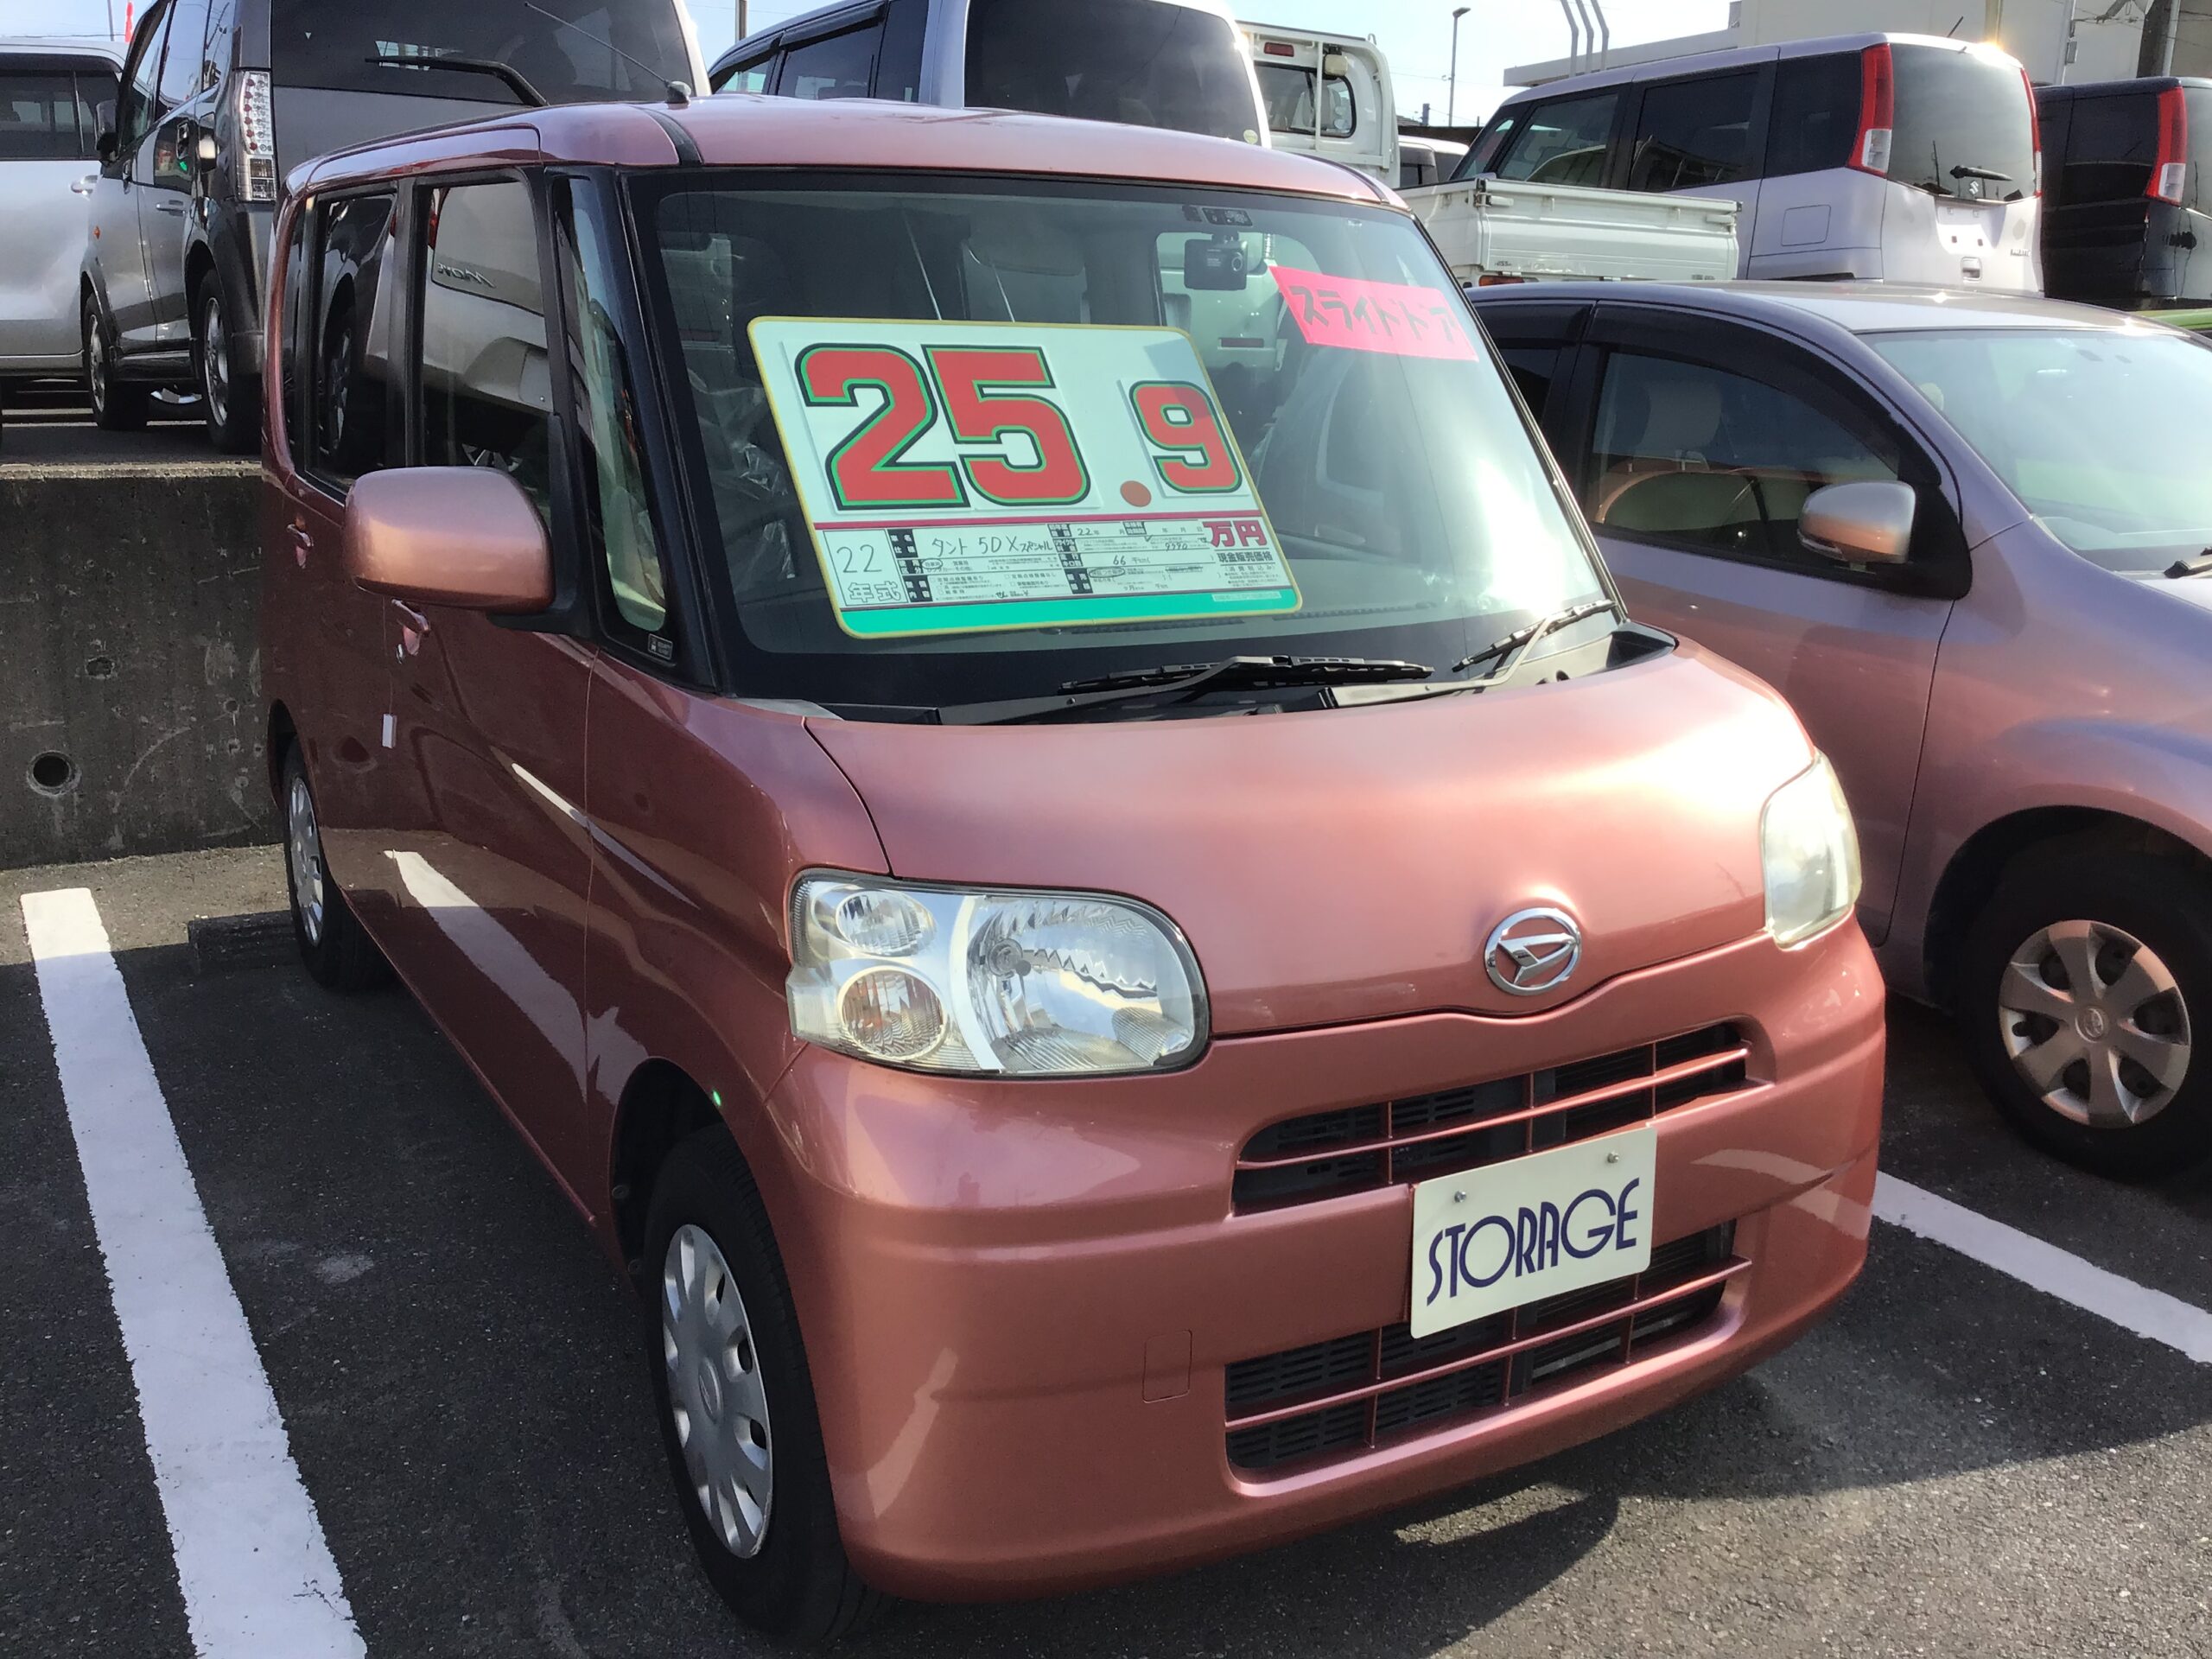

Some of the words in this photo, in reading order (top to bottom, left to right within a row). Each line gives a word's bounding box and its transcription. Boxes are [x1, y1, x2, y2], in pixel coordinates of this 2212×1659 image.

[1202, 520, 1268, 548] 万円
[836, 544, 882, 574] 22
[1113, 555, 1127, 565] 66
[1217, 551, 1274, 563] 現金販売価格
[848, 581, 901, 603] 年式
[1427, 1177, 1639, 1306] STORAGE
